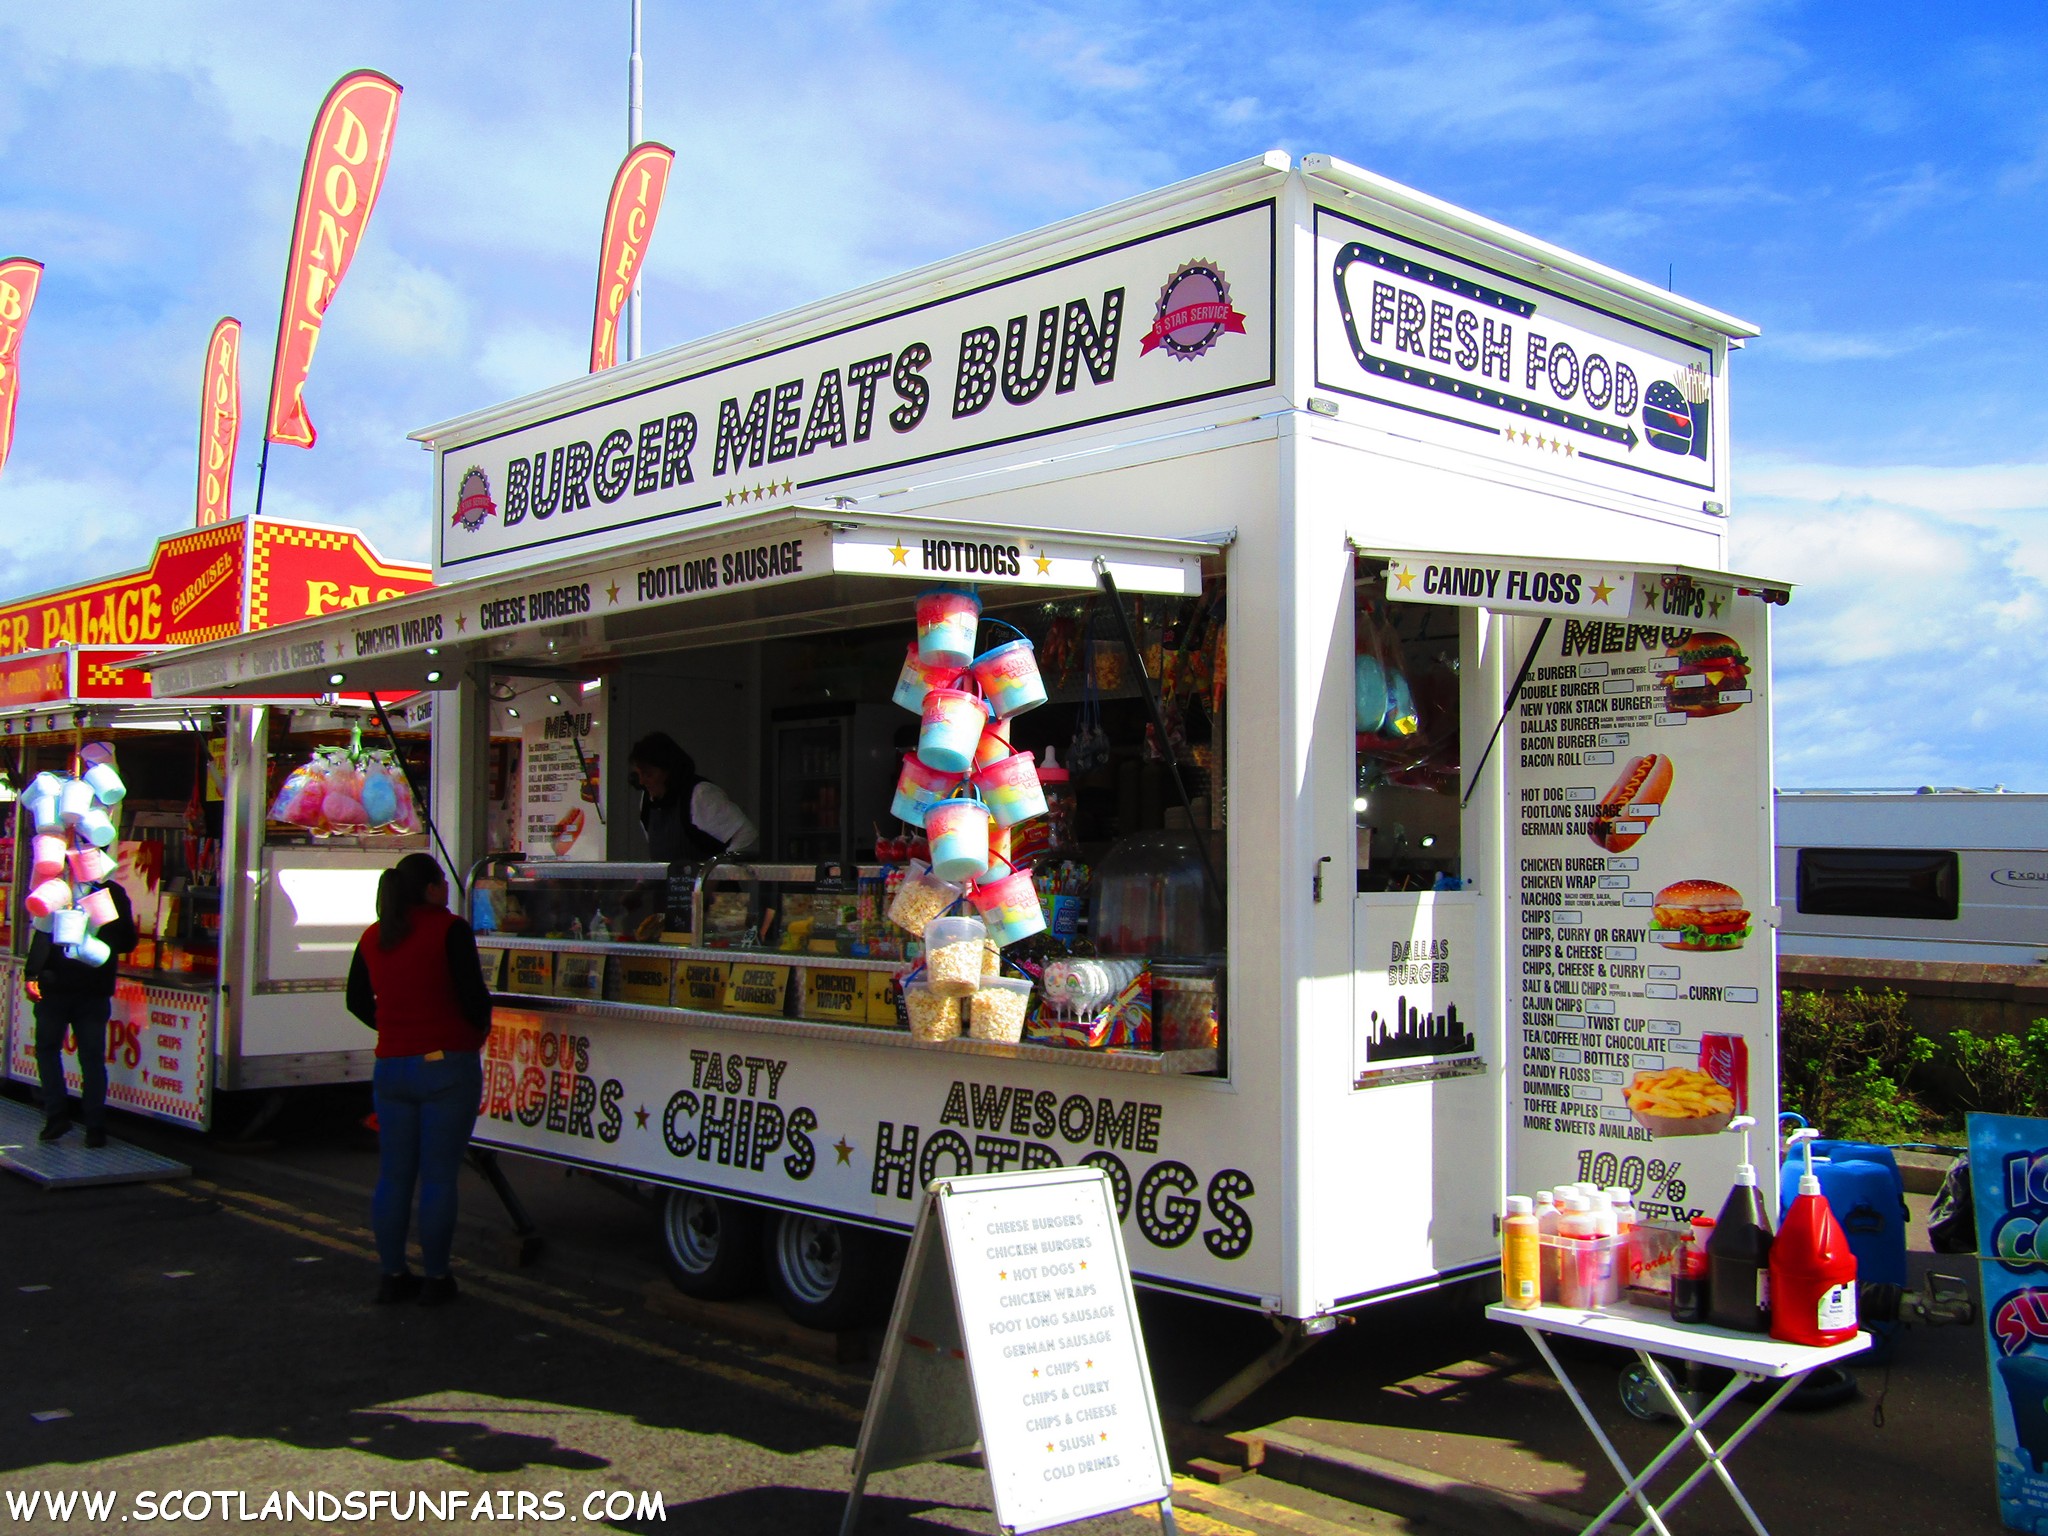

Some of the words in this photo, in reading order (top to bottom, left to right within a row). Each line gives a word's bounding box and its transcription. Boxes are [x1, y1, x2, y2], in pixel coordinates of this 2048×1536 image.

[1155, 321, 1162, 334] 5
[1164, 311, 1188, 330] STAR
[1191, 305, 1229, 321] SERVICE
[1370, 280, 1513, 383] FRESH
[1526, 331, 1638, 418] FOOD
[504, 411, 697, 527] BURGER
[712, 342, 932, 475] MEATS
[952, 287, 1126, 419] BUN
[922, 538, 1021, 576] HOTDOGS
[637, 557, 718, 601] FOOTLONG
[722, 539, 803, 586] SAUSAGE
[171, 552, 233, 616] CAROUSEL
[1423, 565, 1500, 598] CANDY
[1506, 569, 1582, 605] FLOSS
[480, 595, 526, 630] CHEESE
[528, 582, 591, 622] BURGERS
[1662, 583, 1704, 619] CHIPS
[43, 583, 162, 645] PALACE
[356, 624, 400, 656] CHICKEN
[401, 613, 443, 647] WRAPS
[1561, 619, 1693, 657] MENU
[1537, 665, 1577, 681] BURGER
[1610, 667, 1625, 676] WITH
[1626, 666, 1647, 675] CHEESE
[1520, 684, 1558, 700] DOUBLE
[1560, 681, 1600, 697] BURGER
[1520, 703, 1543, 717] NEW
[1546, 700, 1573, 715] YORK
[1576, 698, 1608, 714] STACK
[1611, 696, 1653, 711] BURGER
[1520, 718, 1558, 734] DALLAS
[1560, 716, 1600, 732] BURGER
[1521, 736, 1555, 751] BACON
[1558, 734, 1597, 749] BURGER
[1521, 753, 1555, 768] BACON
[1558, 752, 1582, 767] ROLL
[1521, 788, 1540, 801] HOT
[1543, 787, 1564, 801] DOG
[1521, 804, 1572, 819] FOOTLONG
[1574, 804, 1622, 818] SAUSAGE
[1521, 821, 1563, 836] GERMAN
[1521, 858, 1563, 872] CHICKEN
[1565, 858, 1606, 871] BURGER
[1521, 875, 1563, 889] CHICKEN
[1565, 875, 1597, 888] WRAP
[1521, 892, 1562, 906] NACHOS
[1521, 910, 1551, 924] CHIPS
[1522, 927, 1555, 943] CHIPS,
[1557, 927, 1591, 942] CURRY
[1594, 928, 1609, 942] OR
[1611, 928, 1646, 943] GRAVY
[1391, 938, 1449, 962] DALLAS
[1522, 944, 1551, 958] CHIPS
[1554, 945, 1563, 958] &
[1566, 945, 1604, 960] CHEESE
[627, 970, 662, 987] BURGERS
[686, 965, 709, 983] CHIPS
[712, 966, 720, 982] &
[742, 969, 777, 987] CHEESE
[1389, 963, 1449, 986] BURGER
[1522, 961, 1555, 977] CHIPS,
[1558, 963, 1595, 977] CHEESE
[1597, 963, 1607, 978] &
[1610, 964, 1646, 978] CURRY
[734, 983, 777, 1005] BURGERS
[815, 974, 856, 993] CHICKEN
[1522, 979, 1542, 993] SALT
[1544, 979, 1551, 993] &
[1553, 980, 1579, 995] CHILLI
[1581, 981, 1608, 996] CHIPS
[1688, 985, 1723, 1001] CURRY
[817, 991, 853, 1011] WRAPS
[1522, 996, 1553, 1011] CAJUN
[1555, 997, 1583, 1012] CHIPS
[1522, 1012, 1554, 1027] SLUSH
[1587, 1015, 1621, 1031] TWIST
[1623, 1018, 1646, 1033] CUP
[157, 1034, 182, 1051] CHIPS
[486, 1024, 590, 1073] ELICIOUS
[1523, 1028, 1602, 1048] TEA/COFFEE/HOT
[1605, 1034, 1667, 1053] CHOCOLATE
[1523, 1046, 1551, 1061] CANS
[1583, 1050, 1630, 1068] BOTTLES
[690, 1049, 788, 1100] TASTY
[1523, 1063, 1557, 1080] CANDY
[1559, 1066, 1591, 1082] FLOSS
[1523, 1080, 1570, 1098] DUMMIES
[940, 1081, 1162, 1154] AWESOME
[1523, 1097, 1557, 1114] TOFFEE
[1560, 1101, 1599, 1119] APPLES
[663, 1089, 818, 1182] CHIPS
[1523, 1115, 1552, 1131] MORE
[1554, 1118, 1596, 1136] SWEETS
[1599, 1123, 1654, 1142] AVAILABLE
[1578, 1150, 1687, 1203] 100%
[986, 1219, 1029, 1235] CHEESE
[1032, 1214, 1084, 1231] BURGERS
[986, 1242, 1039, 1260] CHICKEN
[1040, 1236, 1092, 1253] BURGERS
[1012, 1266, 1038, 1281] HOT
[1041, 1262, 1075, 1278] DOGS
[1630, 1253, 1674, 1278] Forks
[1000, 1289, 1052, 1308] CHICKEN
[1053, 1283, 1097, 1301] WRAPS
[988, 1319, 1022, 1336] FOOT
[1025, 1313, 1059, 1330] LONG
[1062, 1305, 1115, 1324] SAUSAGE
[1002, 1338, 1055, 1359] GERMAN
[1059, 1330, 1112, 1350] SAUSAGE
[1045, 1360, 1080, 1377] CHIPS
[1022, 1389, 1058, 1407] CHIPS
[1061, 1387, 1070, 1400] &
[1072, 1380, 1110, 1398] CURRY
[1026, 1414, 1061, 1433] CHIPS
[1065, 1412, 1073, 1425] &
[1076, 1404, 1118, 1423] CHEESE
[1059, 1433, 1096, 1452] SLUSH
[1043, 1464, 1076, 1482] COLD
[1078, 1454, 1120, 1475] DRINKS
